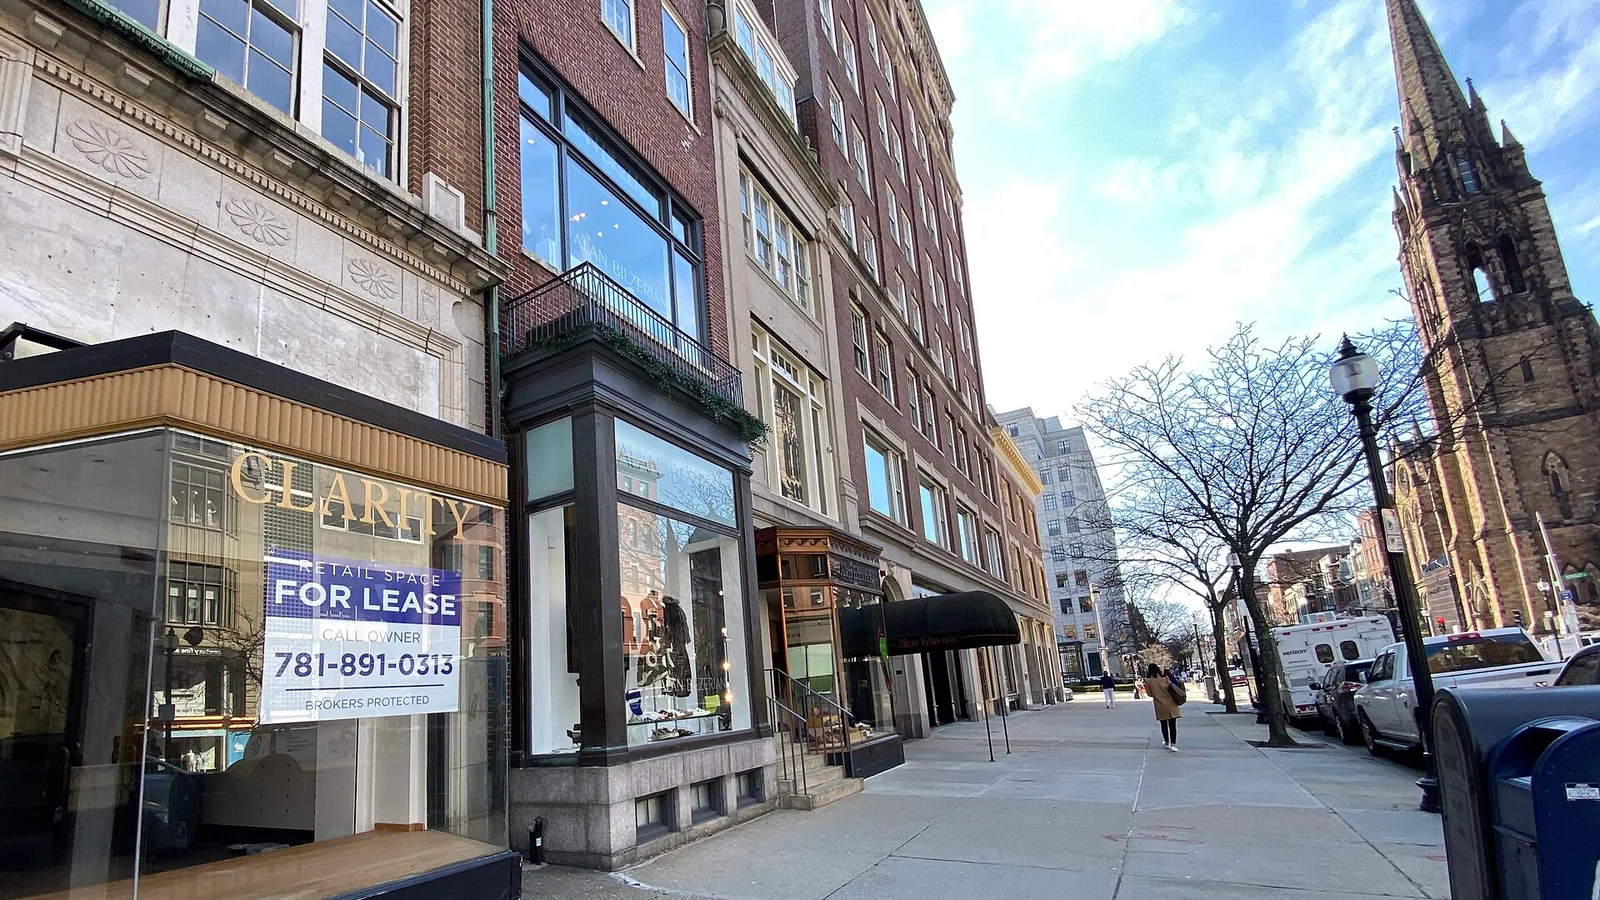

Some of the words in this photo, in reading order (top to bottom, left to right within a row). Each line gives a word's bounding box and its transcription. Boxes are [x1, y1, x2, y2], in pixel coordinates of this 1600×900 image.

[573, 233, 608, 267] ALAN
[612, 260, 666, 308] BILZERIAN
[231, 452, 474, 541] CLARITY
[300, 560, 374, 580] RETAIL
[384, 570, 440, 587] SPACE
[275, 579, 351, 608] FOR
[363, 587, 456, 616] LEASE
[322, 629, 363, 642] CALL
[367, 630, 421, 644] OWNER
[274, 652, 454, 677] 781-891-0313
[686, 677, 726, 691] BZERIAN
[305, 698, 364, 711] BROKERS
[367, 695, 430, 708] PROTECTED
